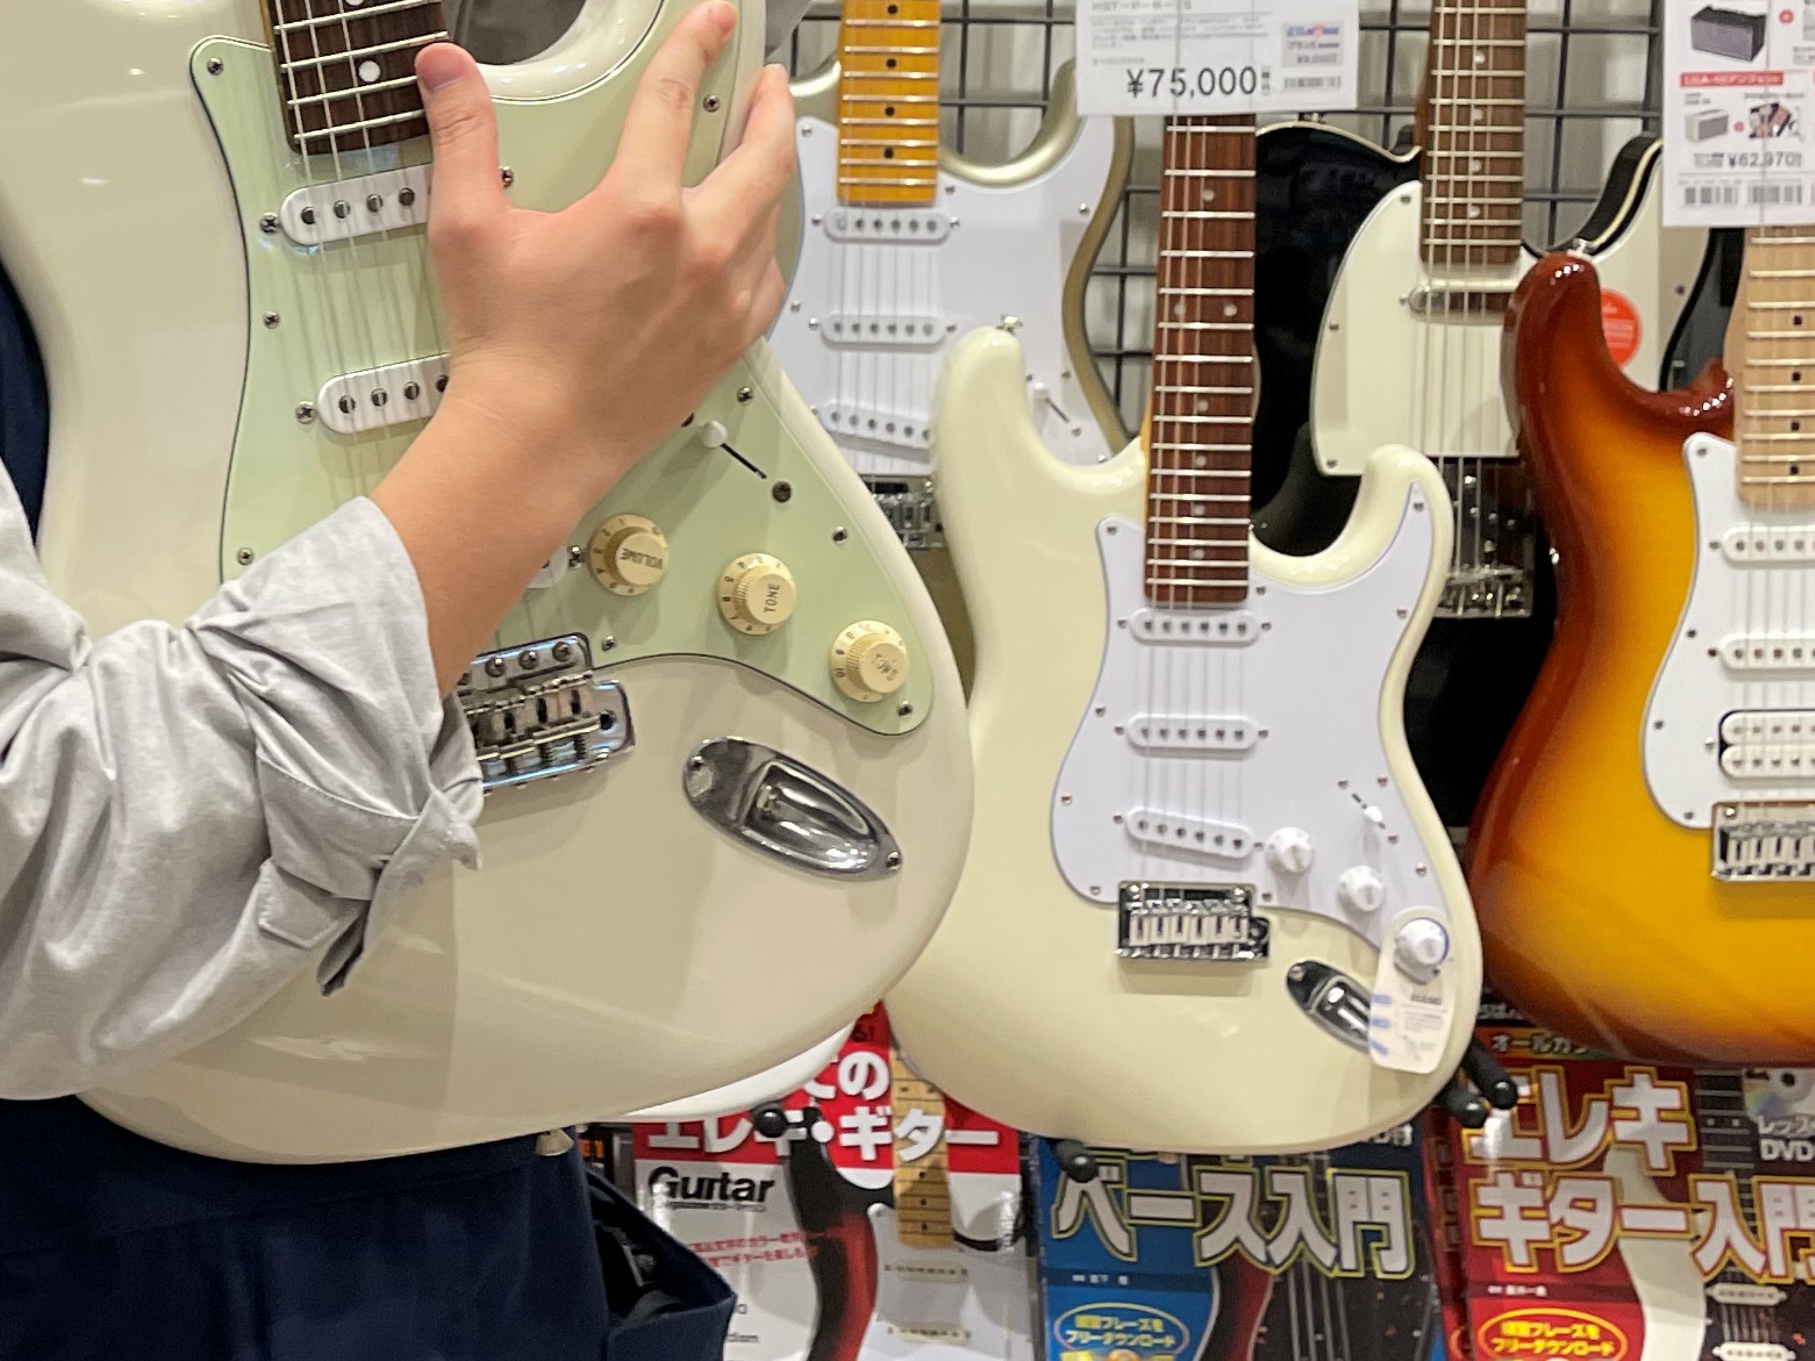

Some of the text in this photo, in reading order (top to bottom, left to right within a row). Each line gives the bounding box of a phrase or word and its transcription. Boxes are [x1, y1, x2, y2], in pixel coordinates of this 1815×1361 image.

[1125, 65, 1258, 100] ¥75,000
[763, 582, 781, 614] TONE
[1462, 1066, 1698, 1176] エレキ
[1760, 1140, 1815, 1162] DVD
[648, 1165, 776, 1203] Guitar
[1051, 1162, 1416, 1280] ベース入門
[1469, 1173, 1815, 1285] ギター入門
[1065, 1329, 1176, 1348] フリーダウンロード
[1491, 1337, 1615, 1357] フリーダウンロード
